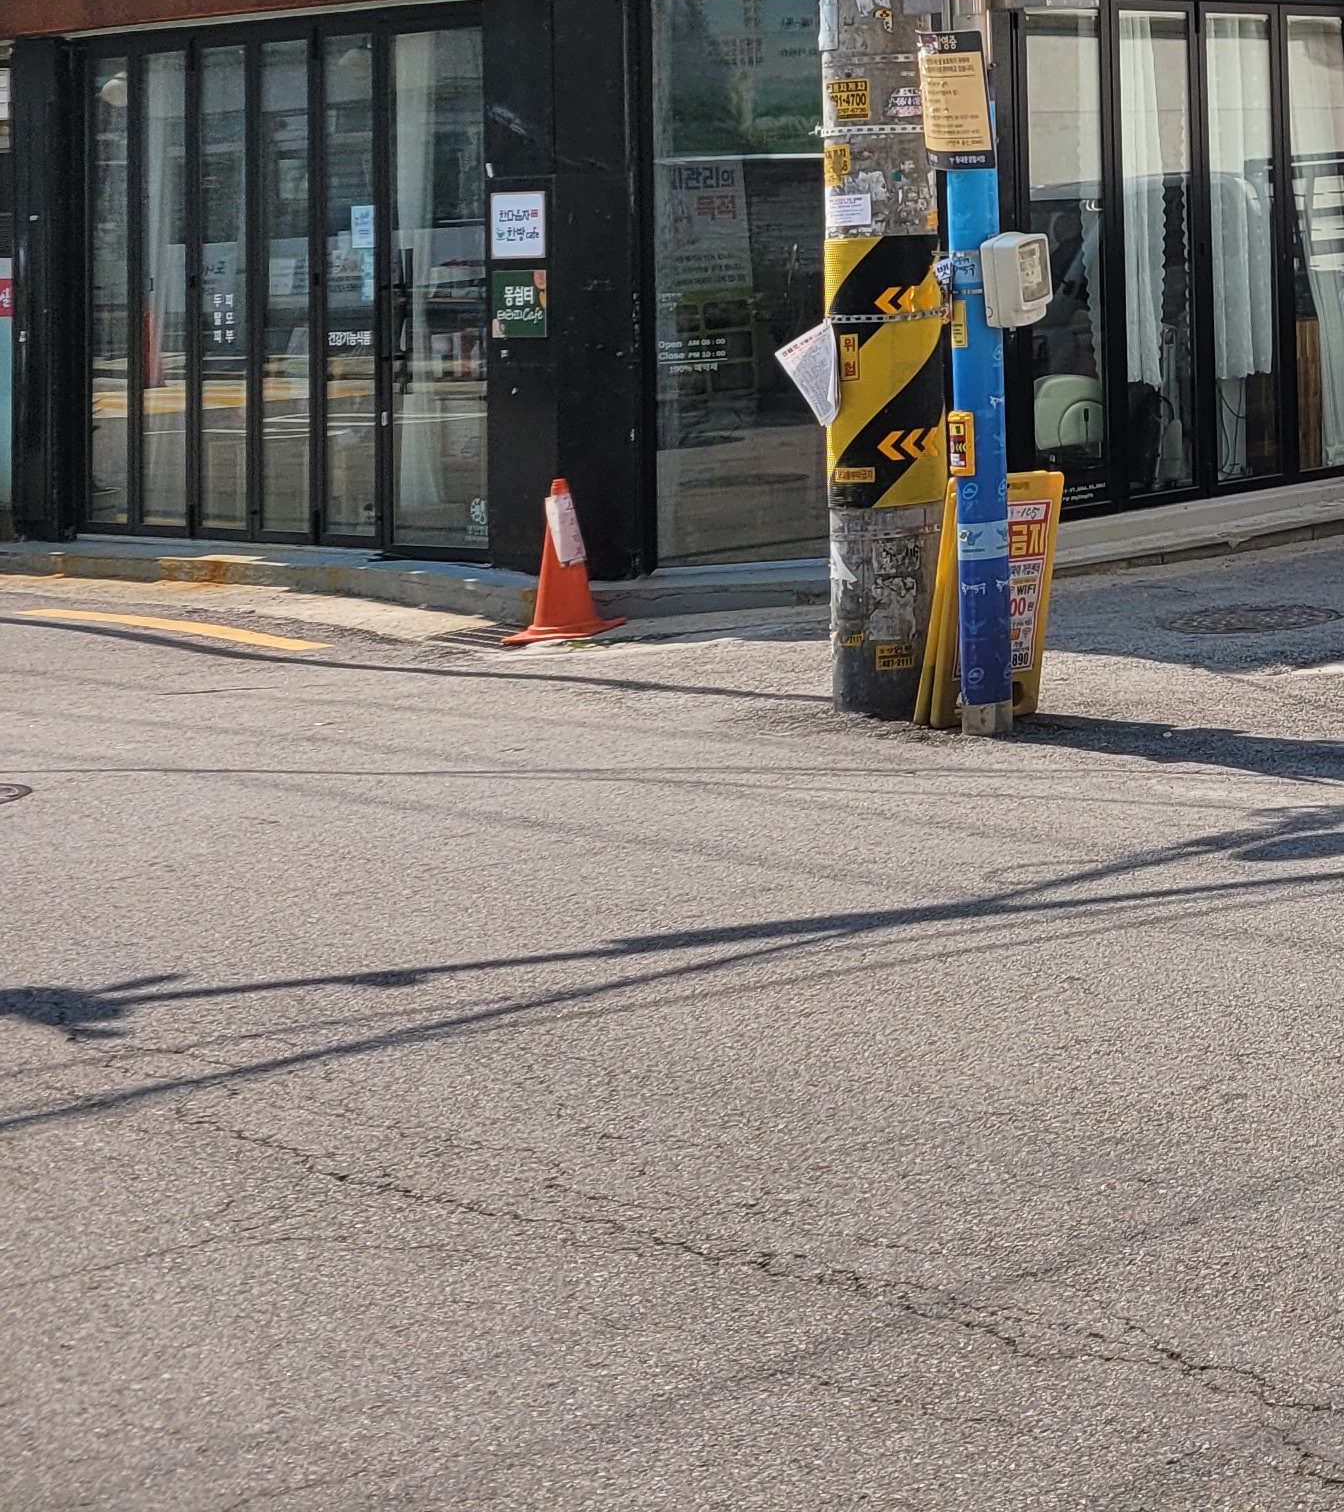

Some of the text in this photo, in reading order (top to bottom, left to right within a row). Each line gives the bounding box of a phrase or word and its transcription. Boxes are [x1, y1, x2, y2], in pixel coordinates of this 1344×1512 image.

[504, 286, 535, 306] 몽쉼터
[658, 340, 683, 350] Open
[687, 339, 700, 347] AM
[659, 351, 685, 360] Close
[687, 351, 700, 359] PM
[1011, 523, 1046, 557] 금지
